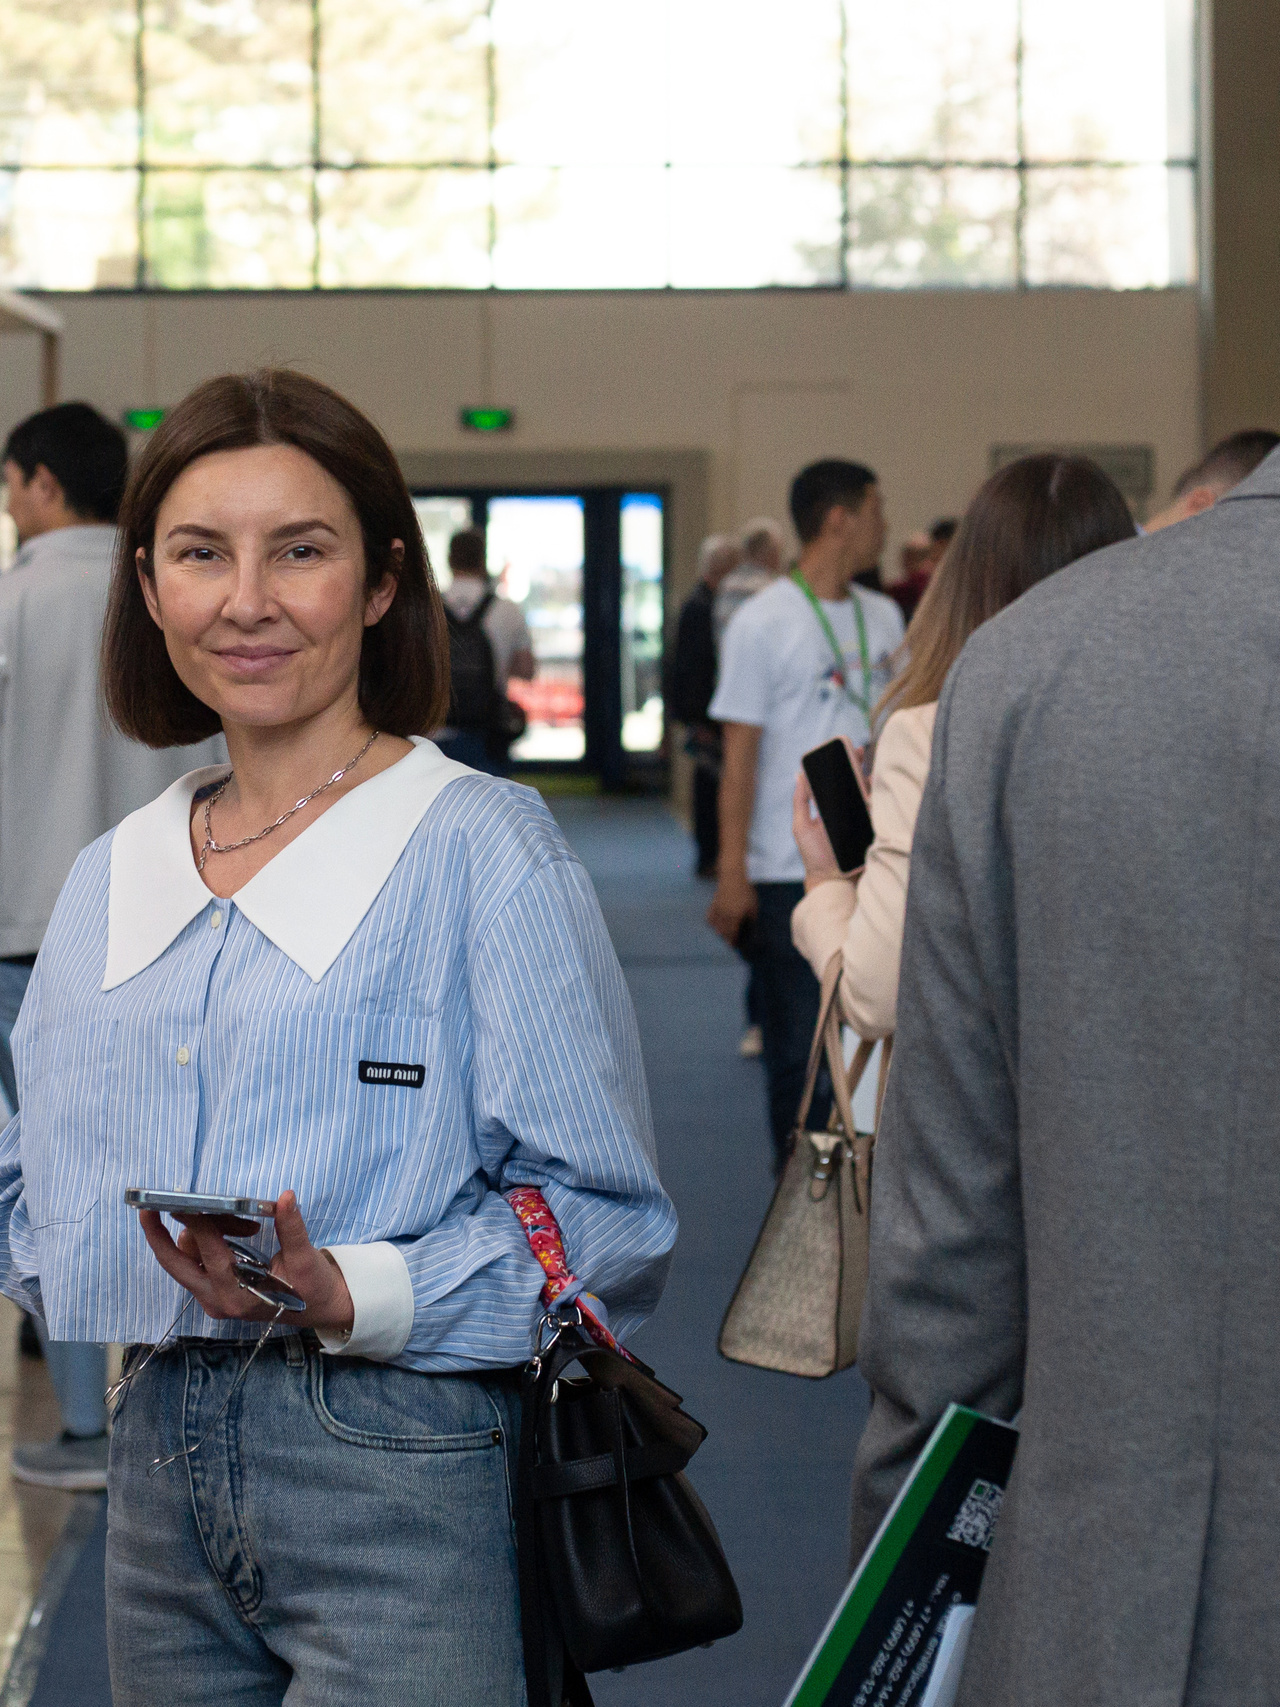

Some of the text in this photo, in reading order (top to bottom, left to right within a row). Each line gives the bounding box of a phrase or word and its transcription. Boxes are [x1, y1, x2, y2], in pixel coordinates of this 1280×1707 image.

[902, 1599, 915, 1618] +7
[920, 1605, 932, 1624] +7
[882, 1616, 907, 1651] (499)
[900, 1622, 924, 1657] (499)
